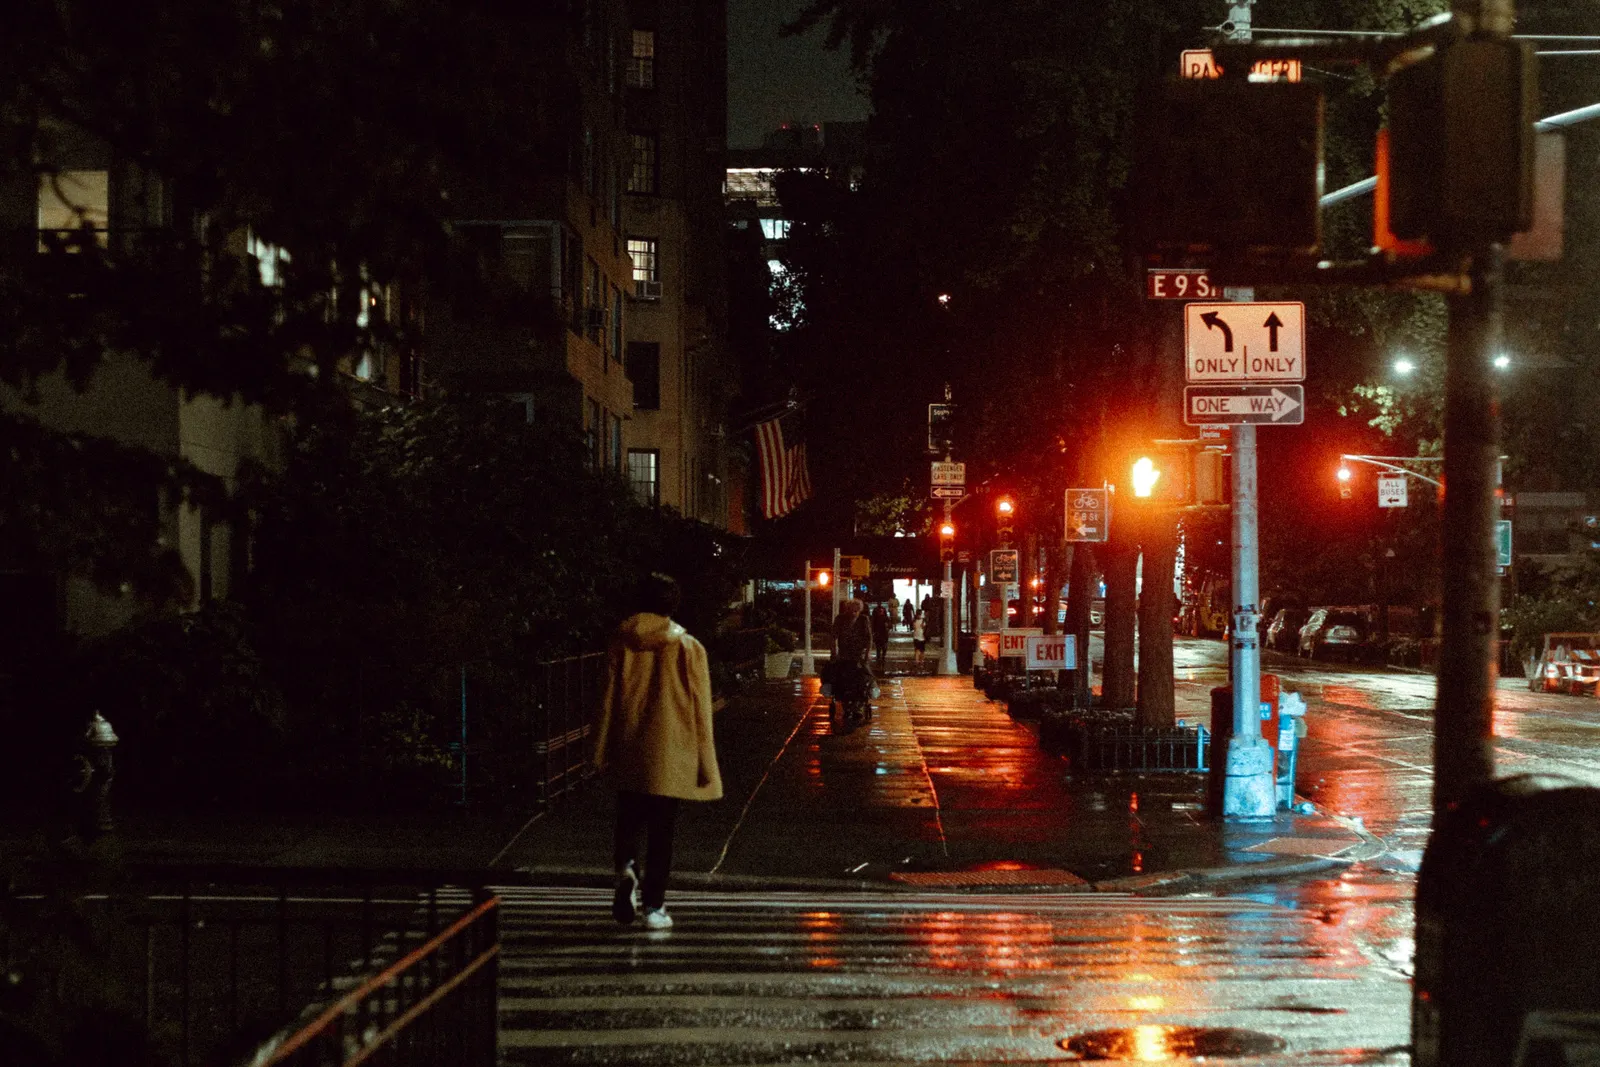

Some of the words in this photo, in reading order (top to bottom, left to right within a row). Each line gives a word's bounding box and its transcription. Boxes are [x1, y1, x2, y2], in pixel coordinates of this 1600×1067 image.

[1154, 275, 1166, 297] E
[1175, 275, 1188, 297] 9
[1194, 358, 1238, 373] ONLY
[1251, 357, 1295, 373] ONLY
[1196, 398, 1230, 412] ONE
[1250, 397, 1287, 412] WAY
[1380, 488, 1405, 496] BUSES
[1003, 635, 1026, 649] ENT
[1036, 644, 1066, 661] EXIT
